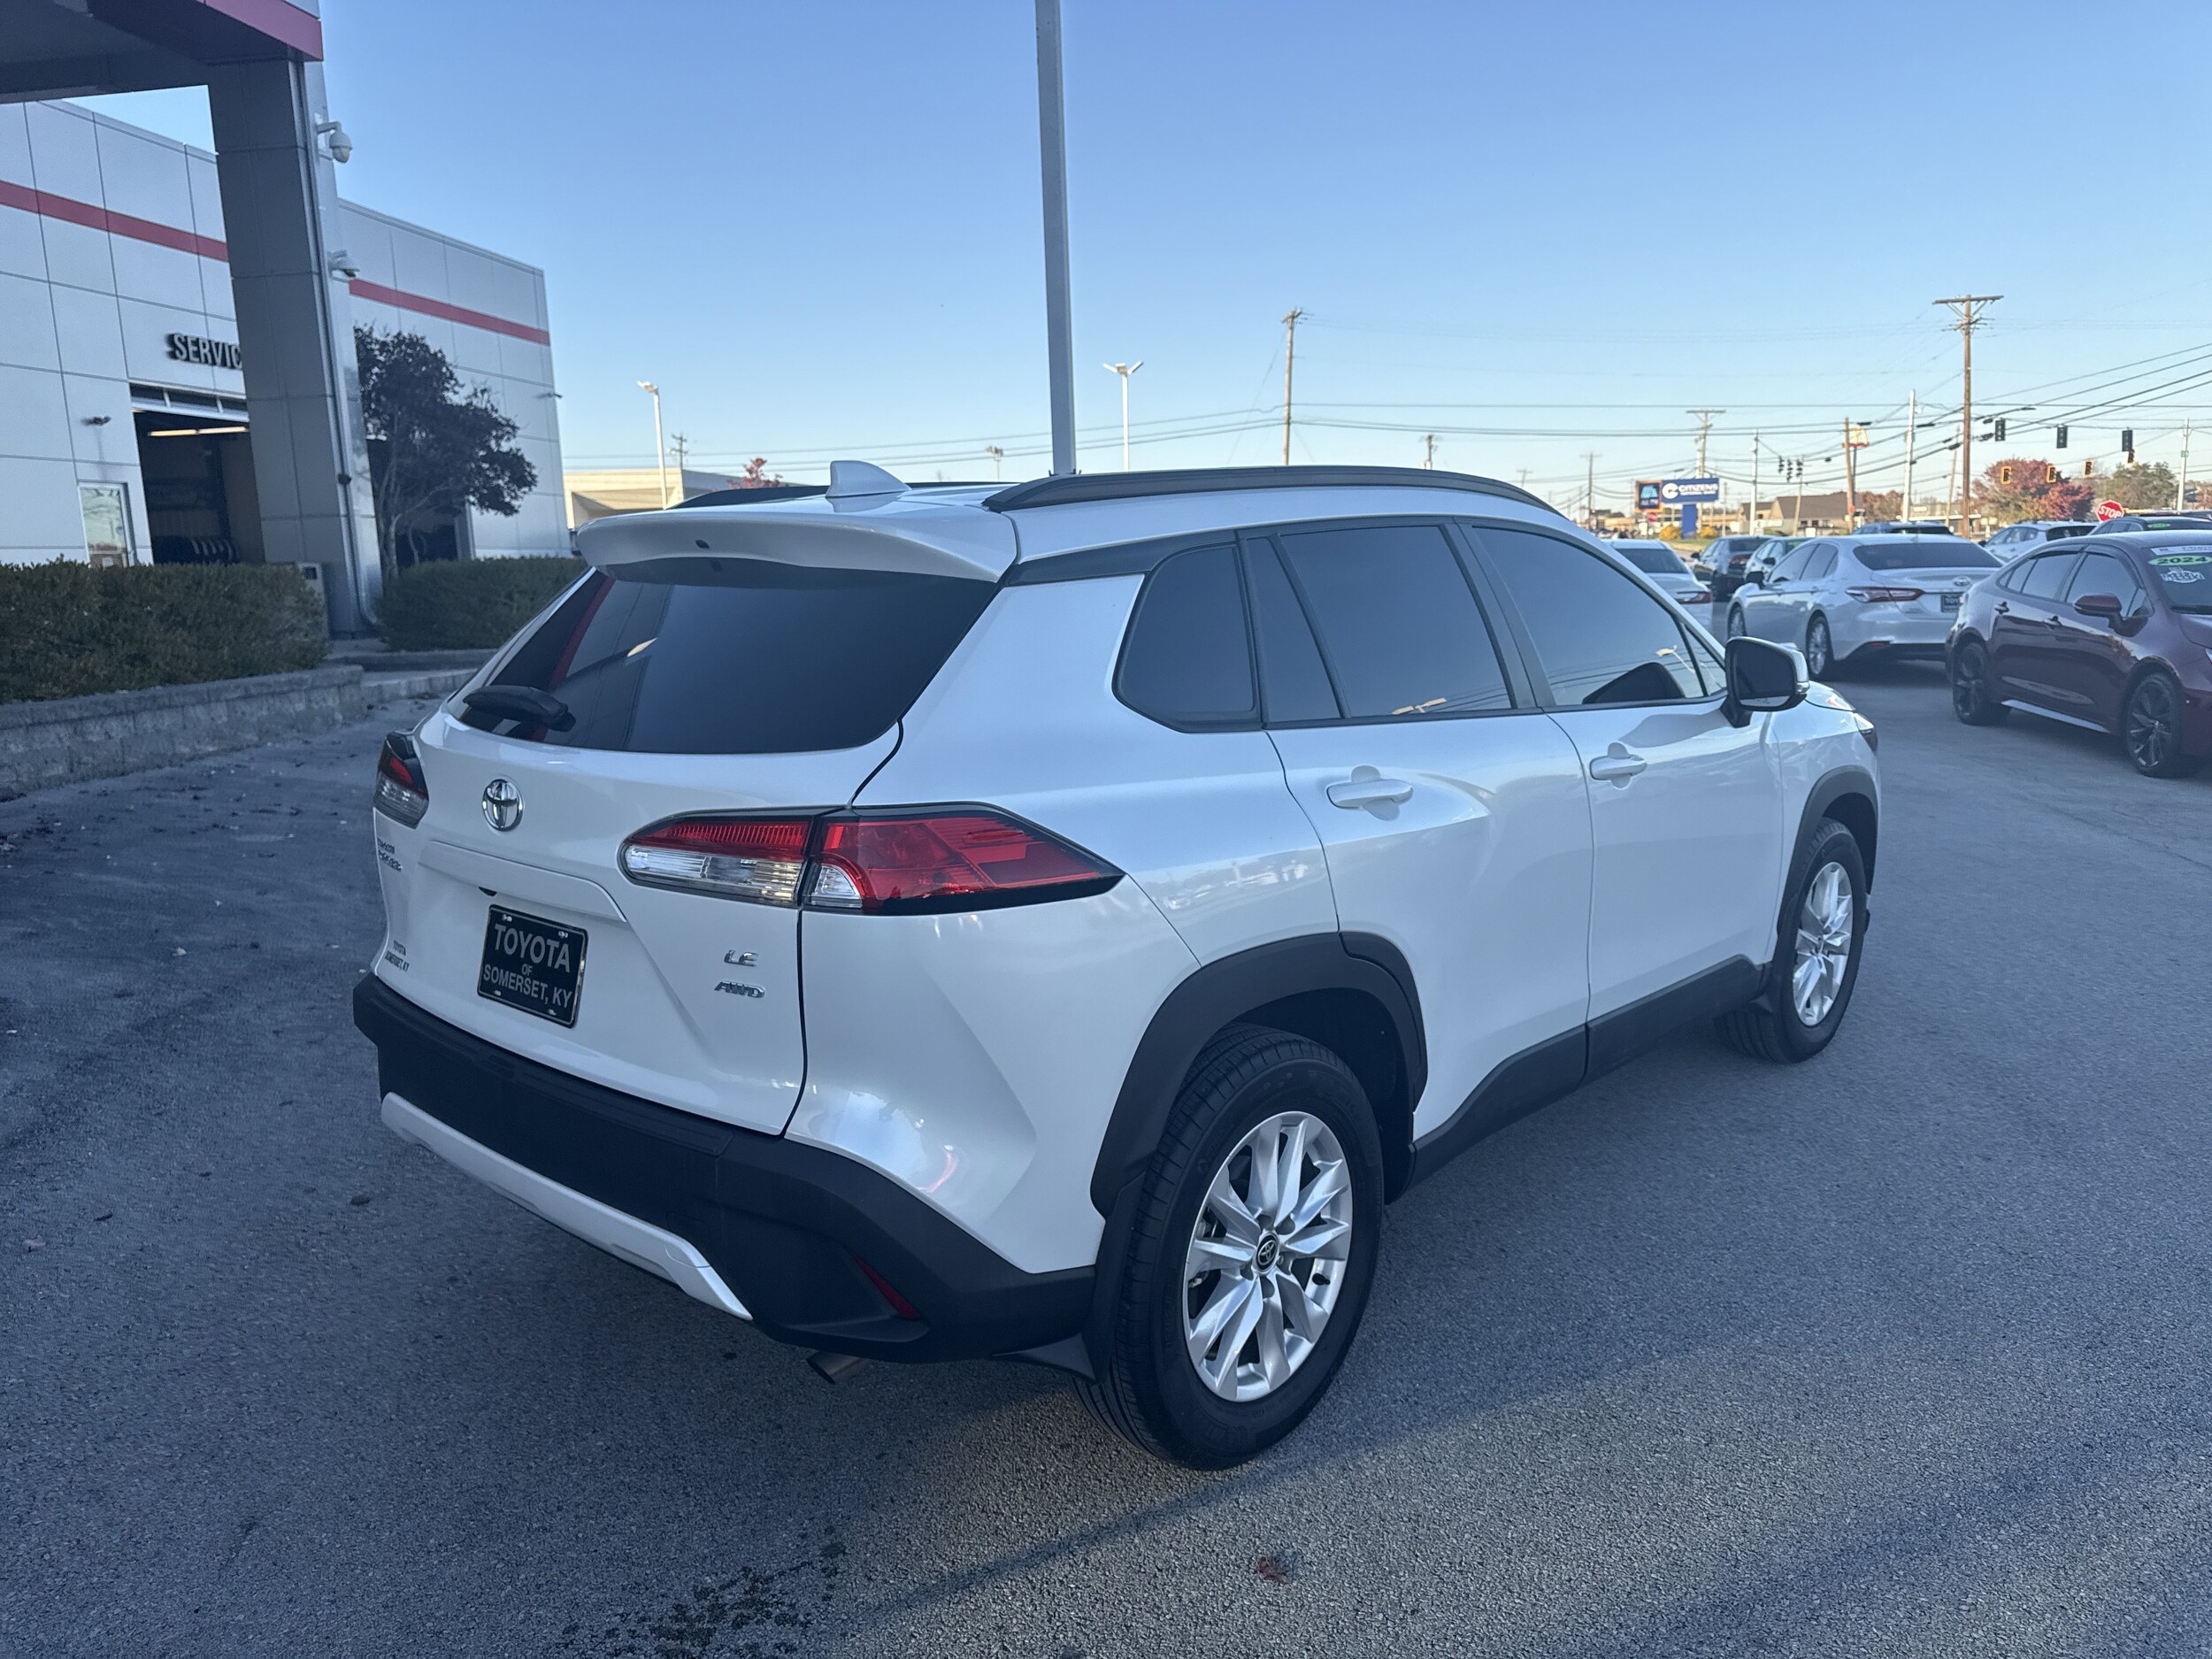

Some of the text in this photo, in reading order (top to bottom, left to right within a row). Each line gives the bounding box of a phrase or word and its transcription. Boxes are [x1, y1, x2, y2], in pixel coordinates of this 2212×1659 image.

[2099, 506, 2123, 518] STOP
[2156, 557, 2208, 565] 2024
[495, 923, 571, 973] TOYOTA
[724, 949, 758, 967] LE
[521, 964, 533, 977] OF
[483, 964, 572, 1009] SOMERSET, KY
[714, 981, 765, 999] AWD
